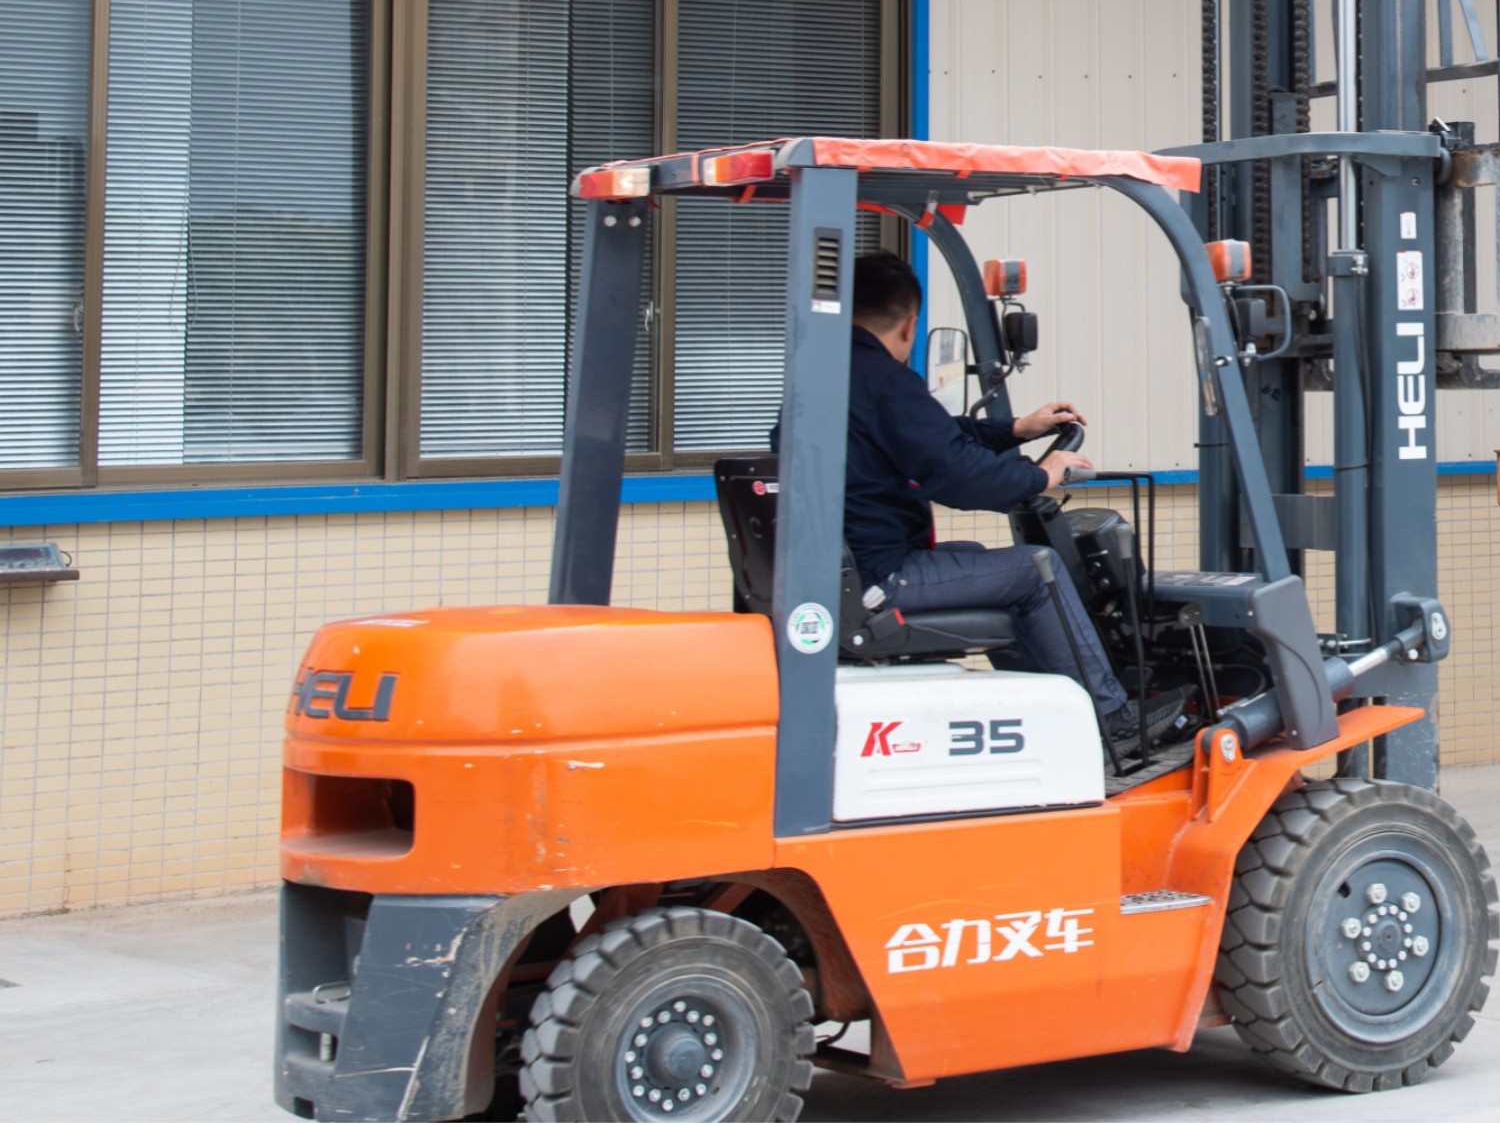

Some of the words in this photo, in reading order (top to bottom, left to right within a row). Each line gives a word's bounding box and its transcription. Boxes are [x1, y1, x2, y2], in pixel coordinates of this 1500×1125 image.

[1396, 322, 1428, 460] HELI
[948, 719, 1026, 756] 35
[883, 907, 1096, 974] 合力叉车
